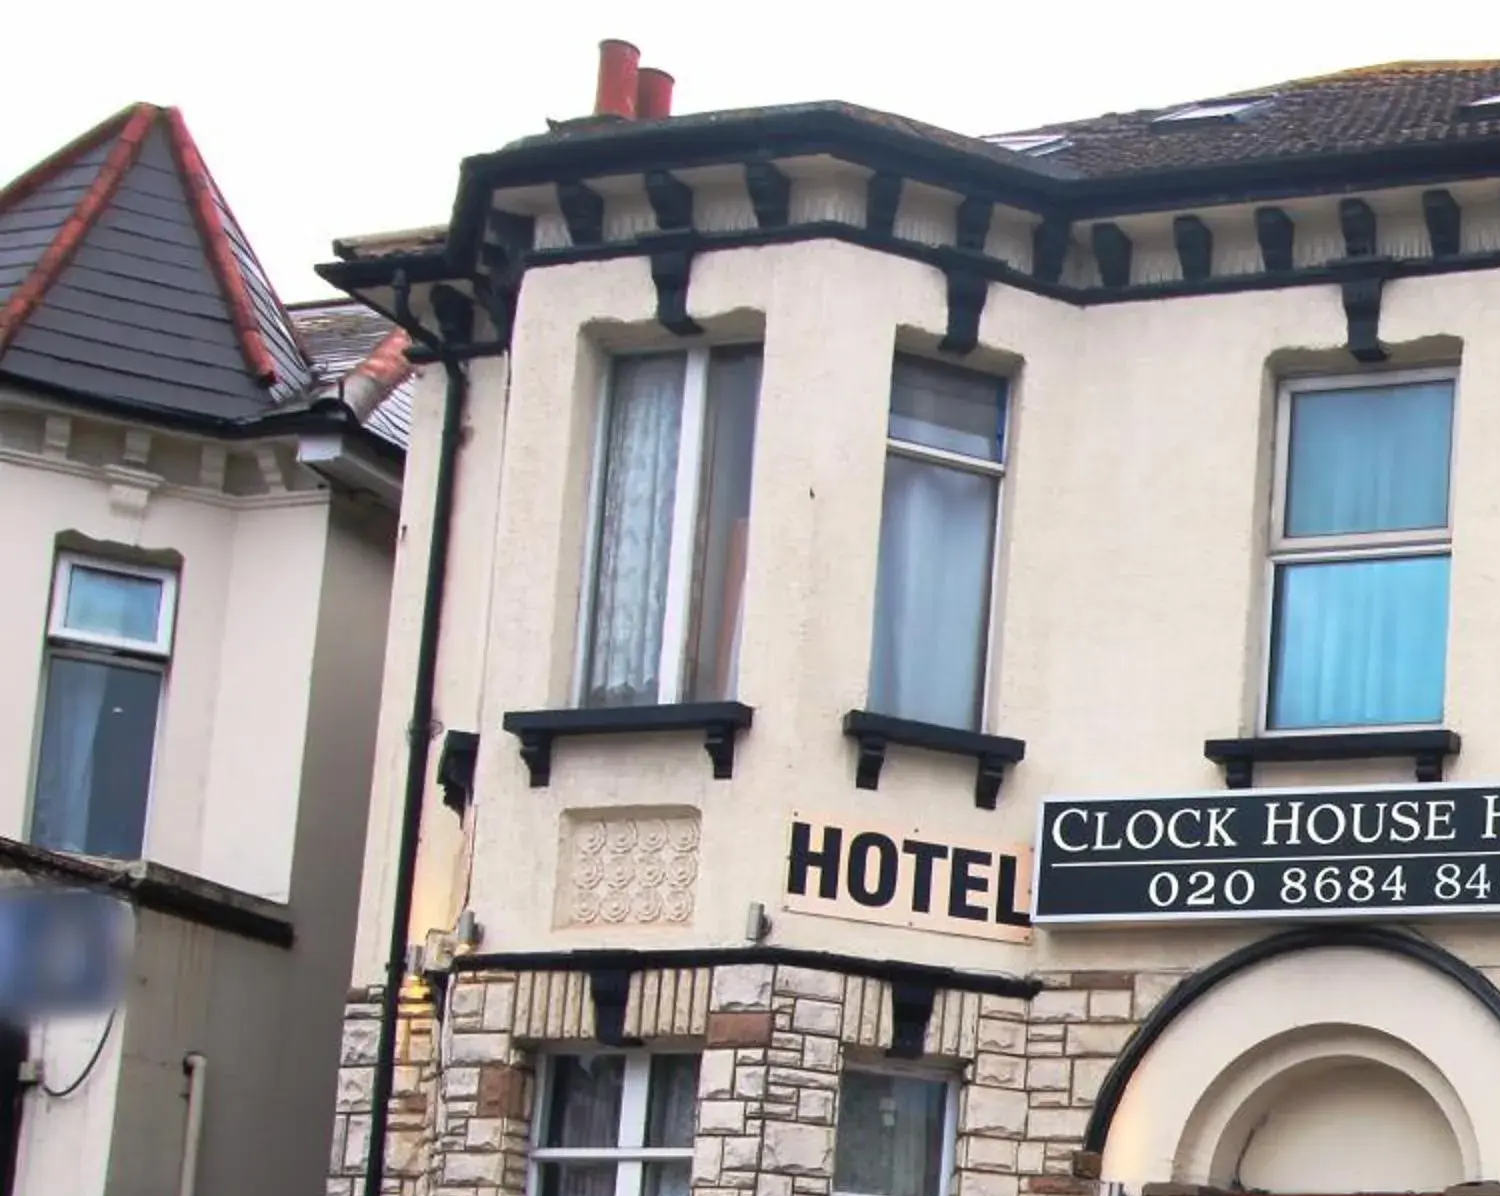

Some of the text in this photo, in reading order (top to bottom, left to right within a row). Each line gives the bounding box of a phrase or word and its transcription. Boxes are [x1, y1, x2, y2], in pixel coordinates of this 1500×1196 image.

[1051, 807, 1237, 852] CLOCK
[1262, 800, 1456, 846] HOUSE
[787, 821, 1035, 929] HOTEL
[1148, 869, 1255, 906] 020
[1280, 865, 1407, 904] 8684
